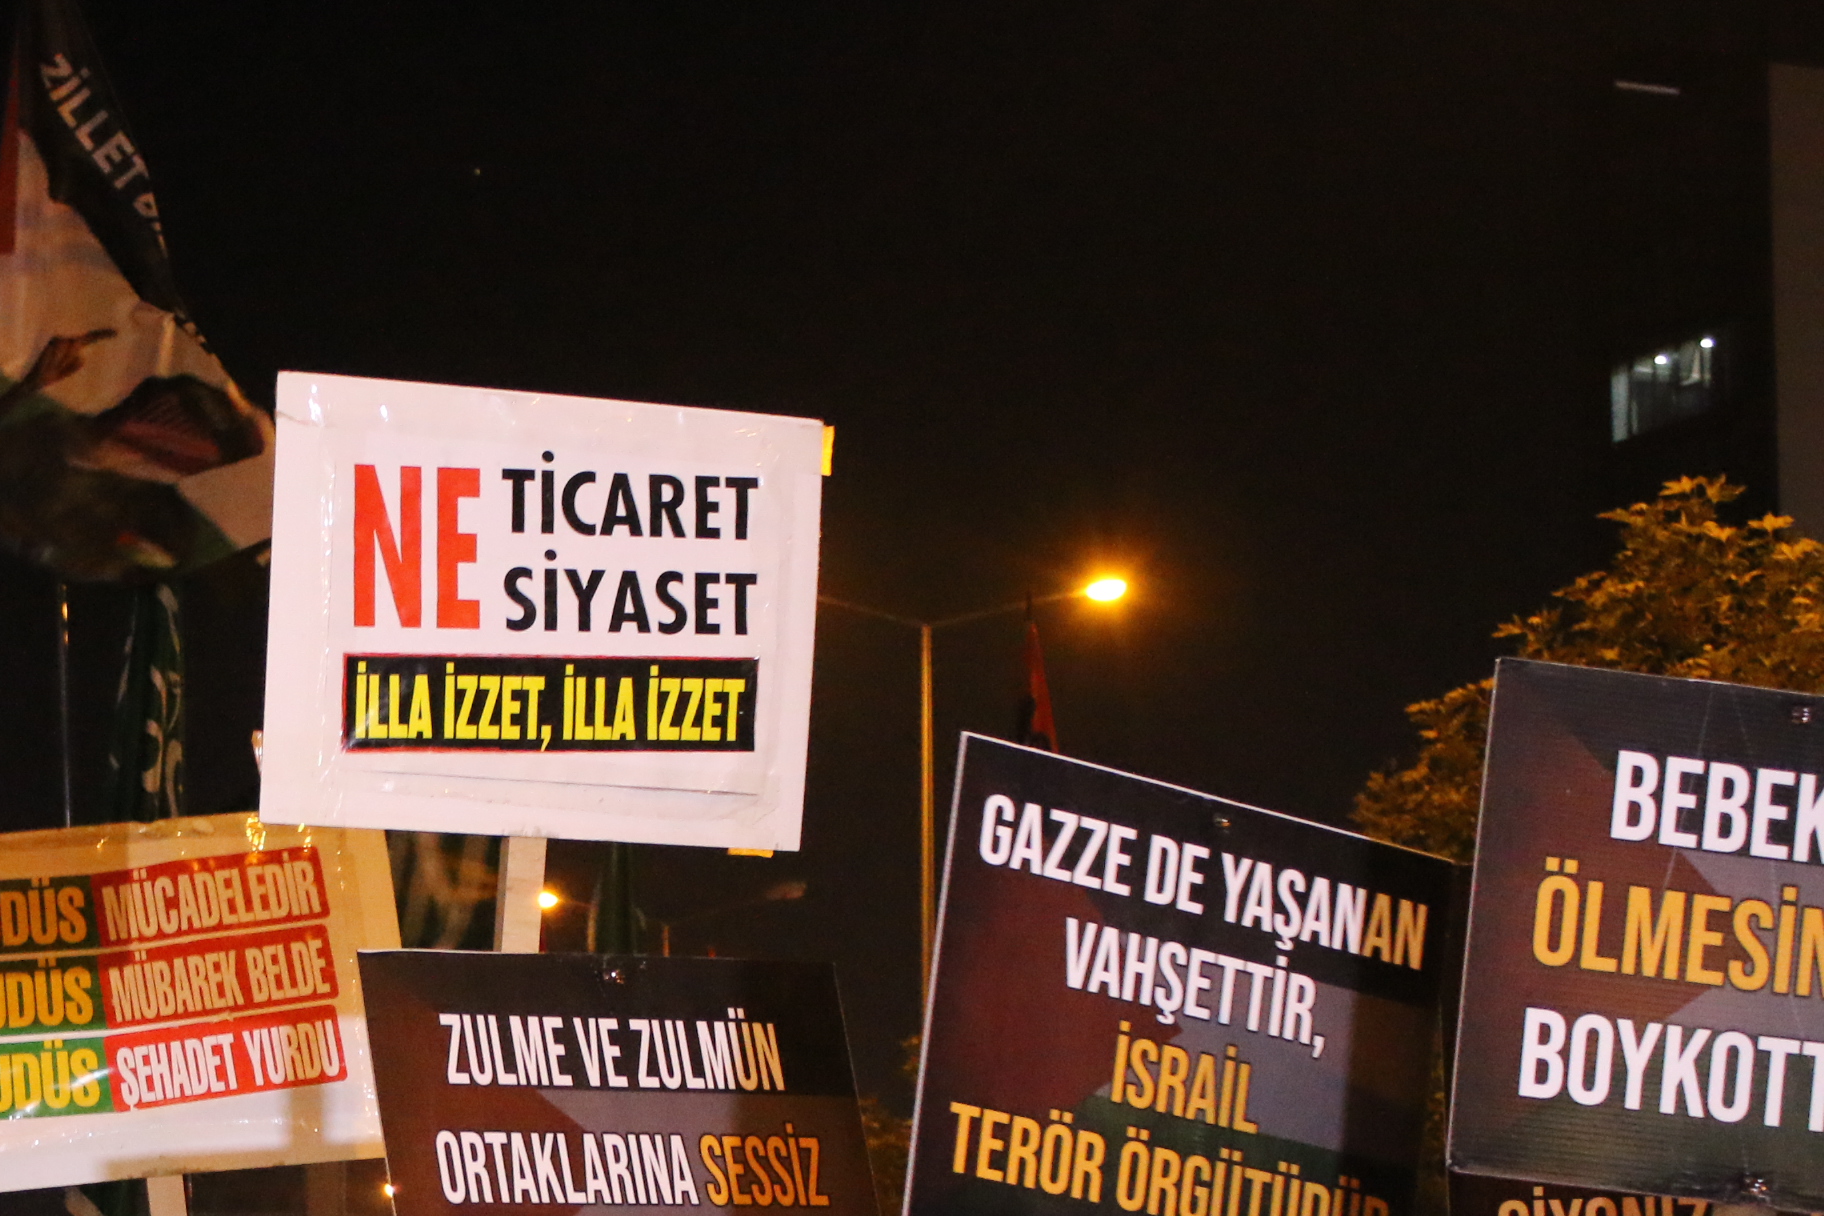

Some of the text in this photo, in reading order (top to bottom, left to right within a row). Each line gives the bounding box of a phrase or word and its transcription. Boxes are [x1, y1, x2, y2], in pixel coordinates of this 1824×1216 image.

[40, 52, 148, 192] ZİLLET
[501, 450, 760, 541] TİCARET
[353, 463, 481, 630] NE
[503, 548, 758, 636] SİYASET
[355, 660, 746, 752] İLLA İZZET, İLLA İZZET
[102, 852, 321, 941] MÜCADELEDİR
[979, 794, 1428, 971] GAZZE DE YAŞANAN
[108, 950, 245, 1023] MÜBAREK
[245, 939, 331, 1004] BELDE
[1065, 917, 1326, 1060] VAHŞETTİR,
[242, 1018, 341, 1087] YURDU
[439, 1007, 785, 1091] ZULME VE ZULMÜN
[1110, 1020, 1259, 1134] İSRAİL
[435, 1122, 830, 1207] ORTAKLARINA SESSİZ
[949, 1101, 1106, 1204] TERÖR
